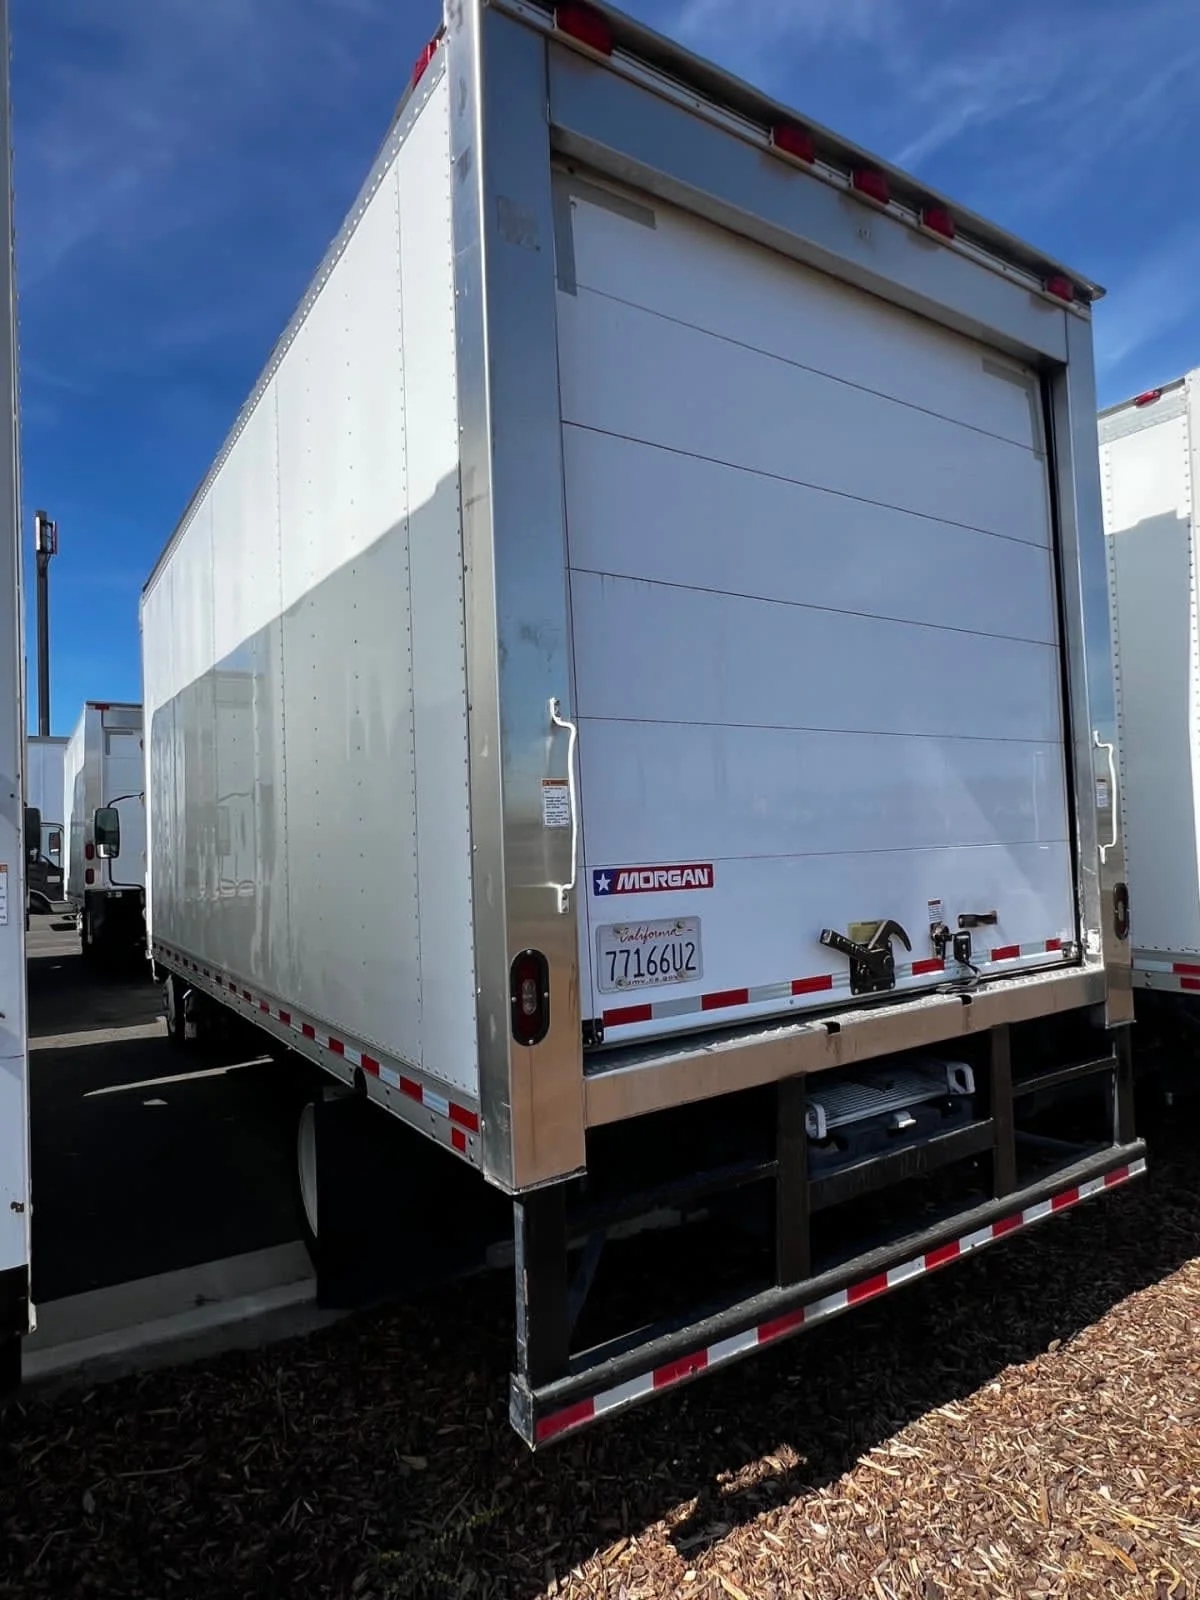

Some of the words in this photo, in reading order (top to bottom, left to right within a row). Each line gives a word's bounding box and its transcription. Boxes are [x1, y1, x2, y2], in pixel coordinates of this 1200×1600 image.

[617, 868, 708, 891] MORGAN
[619, 926, 684, 944] California
[605, 942, 696, 982] 77166U2
